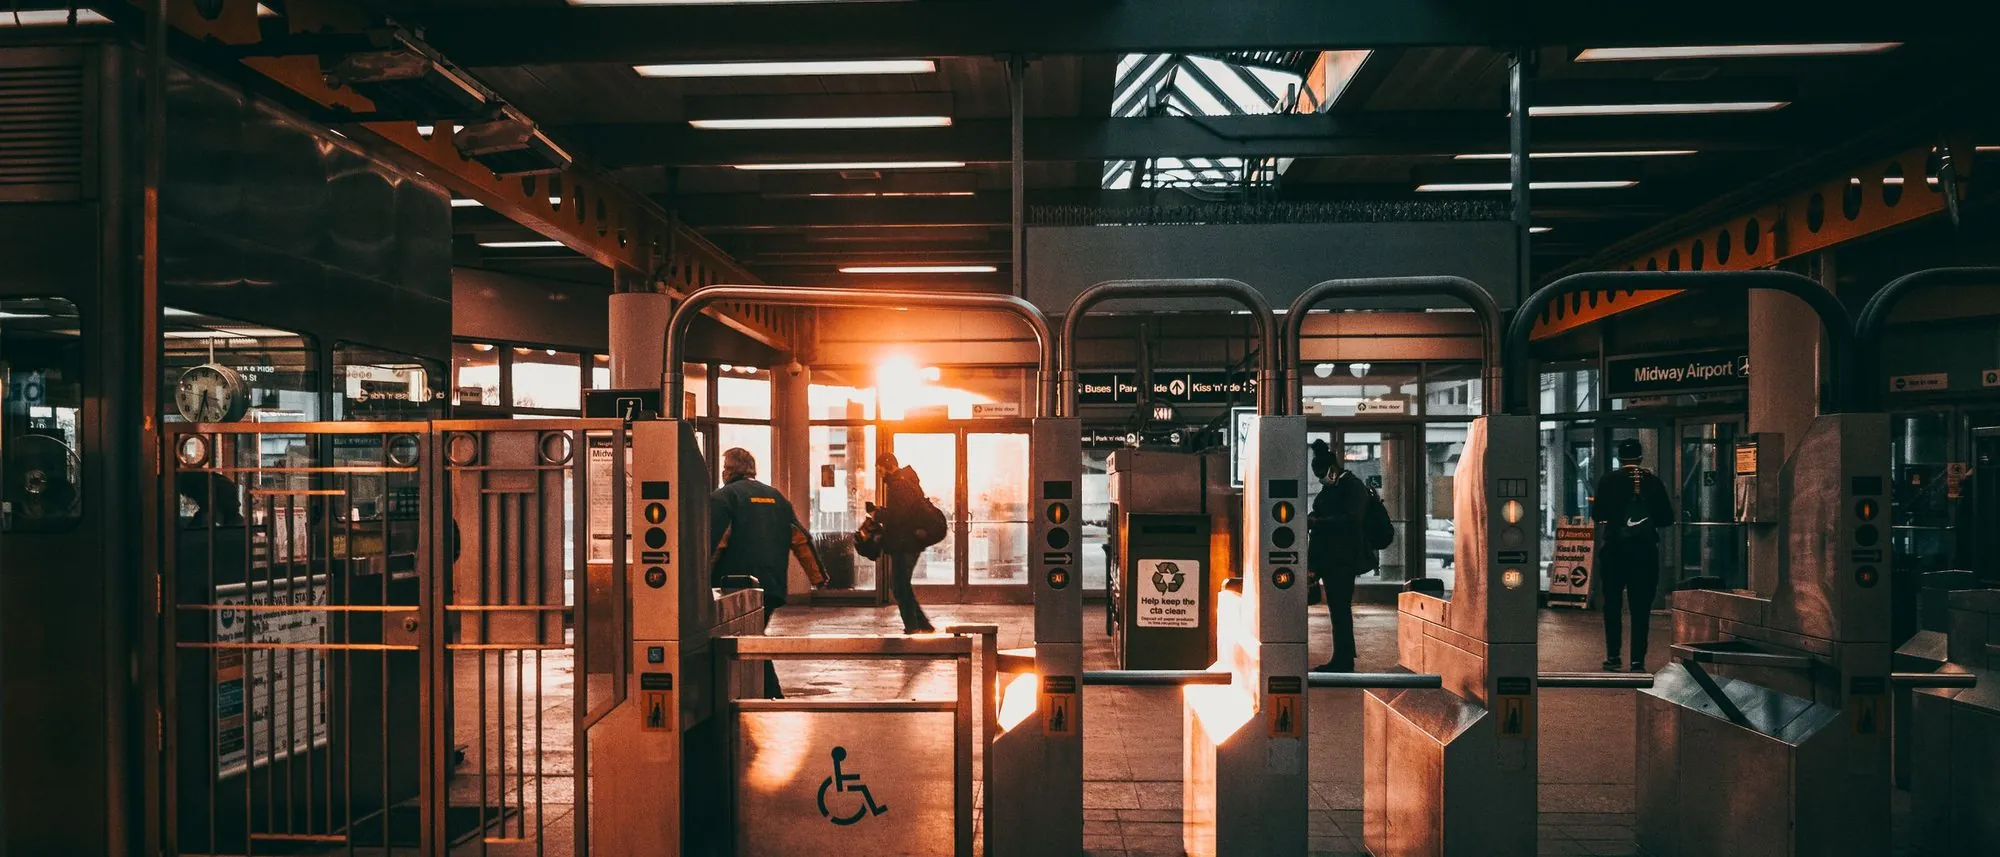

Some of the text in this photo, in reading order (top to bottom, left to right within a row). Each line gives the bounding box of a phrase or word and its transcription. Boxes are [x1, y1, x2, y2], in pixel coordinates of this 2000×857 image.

[1634, 361, 1733, 382] Midway Airport
[1085, 383, 1112, 394] Buses
[1153, 383, 1168, 393] ide
[1192, 382, 1212, 393] Kiss
[1223, 383, 1241, 393] rde
[592, 449, 613, 458] Midw
[1577, 545, 1591, 553] Ride
[1504, 571, 1520, 583] EXIT
[1141, 597, 1196, 606] Help keep the
[1150, 607, 1186, 615] cta clean
